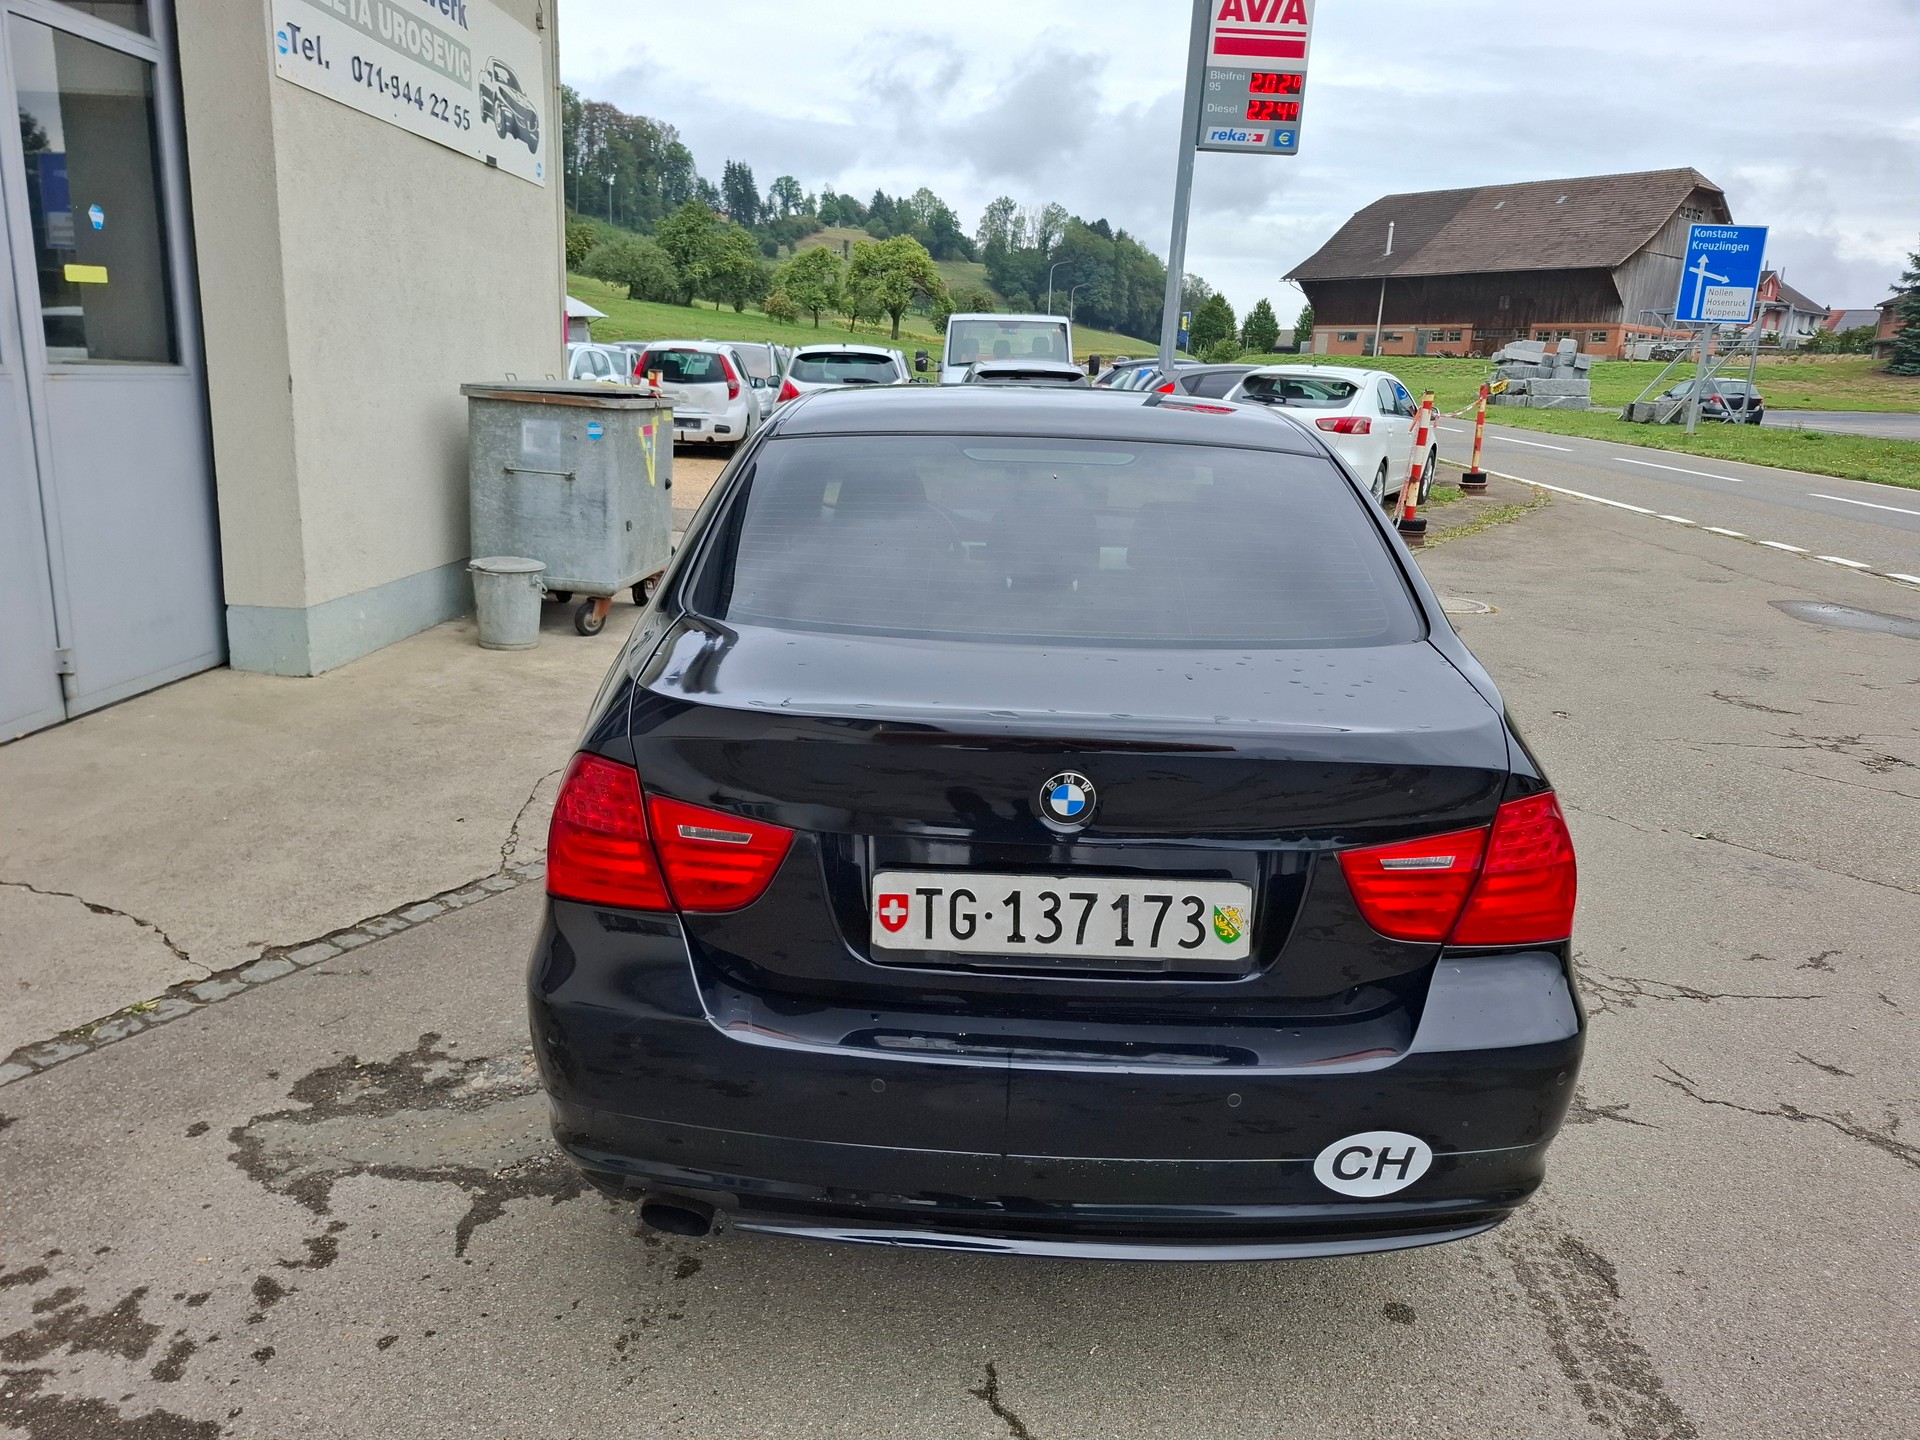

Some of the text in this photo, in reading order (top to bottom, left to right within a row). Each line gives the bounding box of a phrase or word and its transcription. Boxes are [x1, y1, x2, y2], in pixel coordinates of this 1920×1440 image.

[1217, 0, 1308, 25] AVIA
[378, 2, 471, 82] UROSEVIC
[287, 22, 330, 70] Tel.
[430, 93, 449, 122] 22
[454, 105, 471, 131] 55
[1210, 70, 1246, 81] Bleifrei
[1208, 82, 1221, 91] 95
[1207, 103, 1238, 114] Diesel
[1694, 228, 1739, 239] Konstanz
[1692, 241, 1750, 253] Kreuzlingen
[1708, 288, 1734, 296] Nollen
[1706, 298, 1747, 307] Hosenruck
[1705, 308, 1746, 318] Wuppenau
[1046, 774, 1092, 793] BMW
[1332, 1145, 1417, 1181] CH
